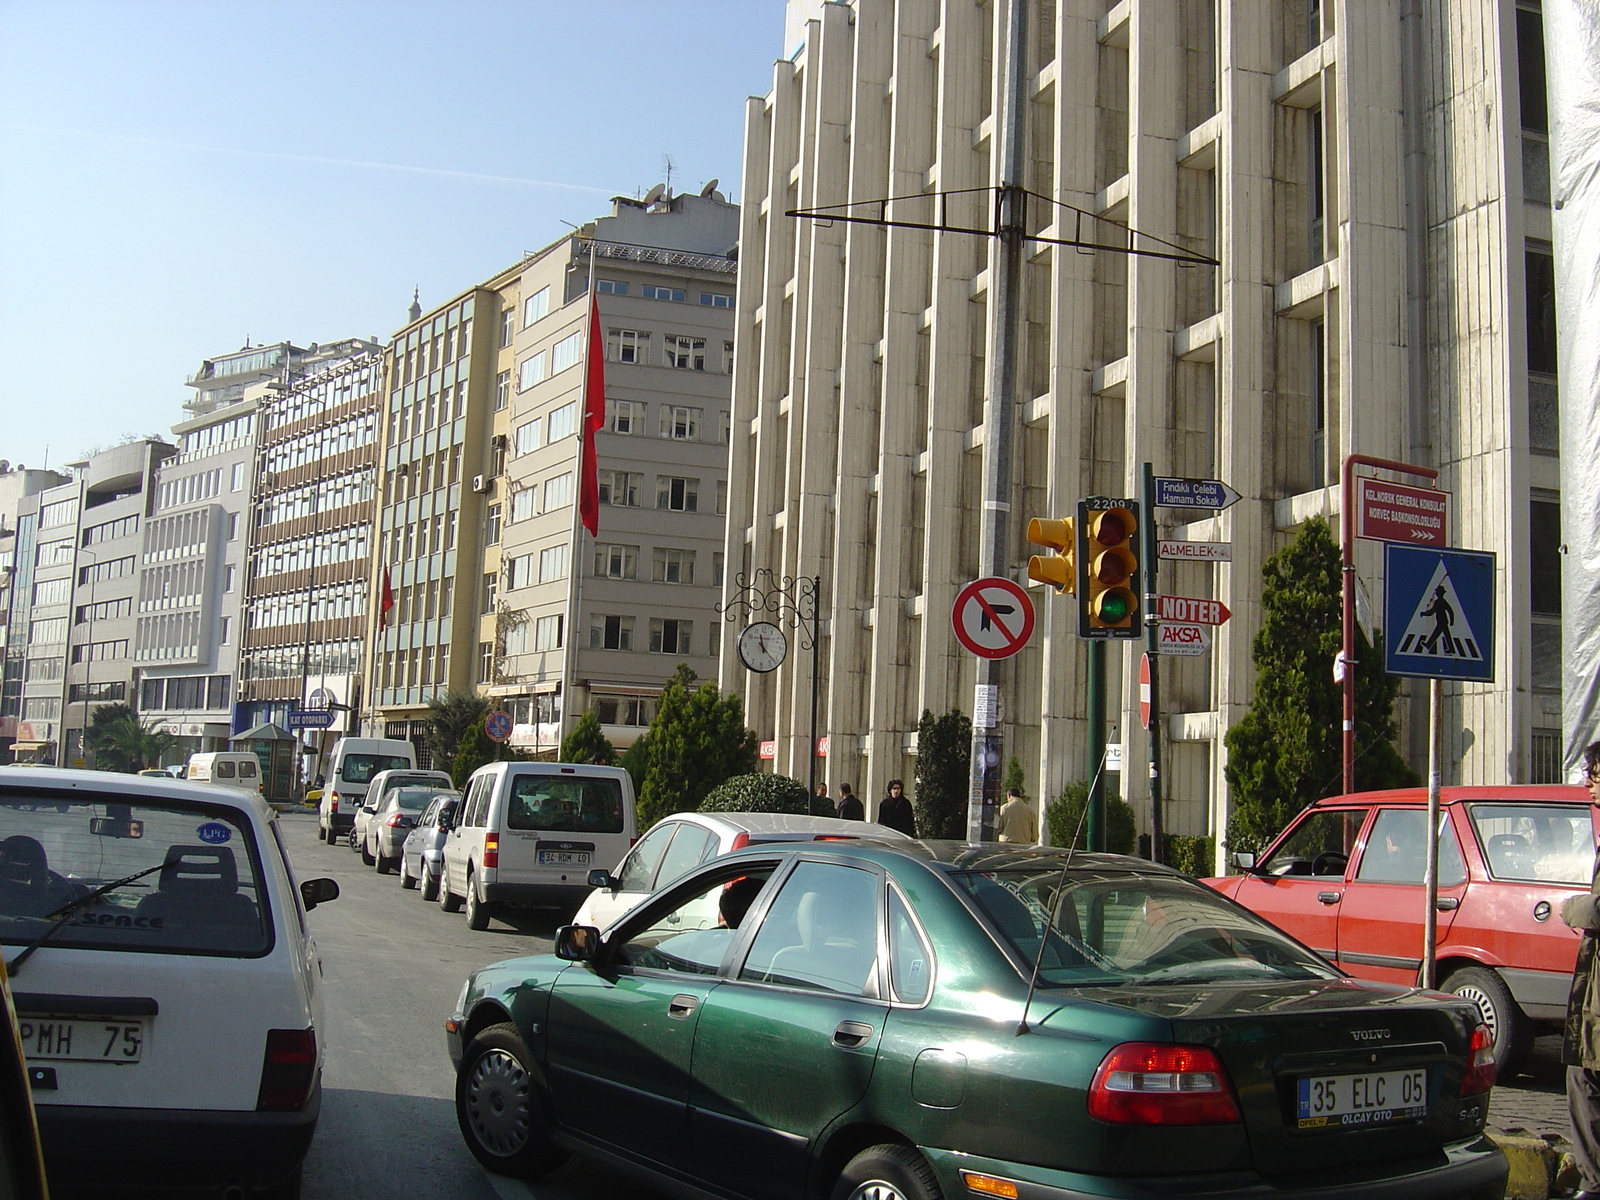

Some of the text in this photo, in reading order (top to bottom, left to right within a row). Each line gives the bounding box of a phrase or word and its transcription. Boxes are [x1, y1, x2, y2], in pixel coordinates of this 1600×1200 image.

[1093, 499, 1126, 509] 2209
[1163, 493, 1219, 506] Hamamı Sokak
[1396, 494, 1419, 508] GENERAL
[1419, 498, 1446, 513] KONSULAT
[1369, 507, 1441, 529] NORVEÇ BAŞKONSOLOSLUĞU
[1162, 597, 1220, 624] NOTER
[1162, 627, 1203, 643] AKSA
[203, 828, 226, 839] LPG
[545, 853, 555, 862] 34
[558, 853, 572, 862] RDM
[82, 912, 164, 929] SPACE
[20, 1023, 140, 1057] PMH 75
[1350, 1029, 1391, 1041] VOLVO
[1313, 1073, 1423, 1112] 35 ELC 05
[1300, 1101, 1310, 1111] TR
[1459, 1106, 1480, 1121] S40
[1299, 1117, 1318, 1127] OPEL
[1341, 1112, 1372, 1125] OLCAY
[1373, 1110, 1392, 1122] OTO
